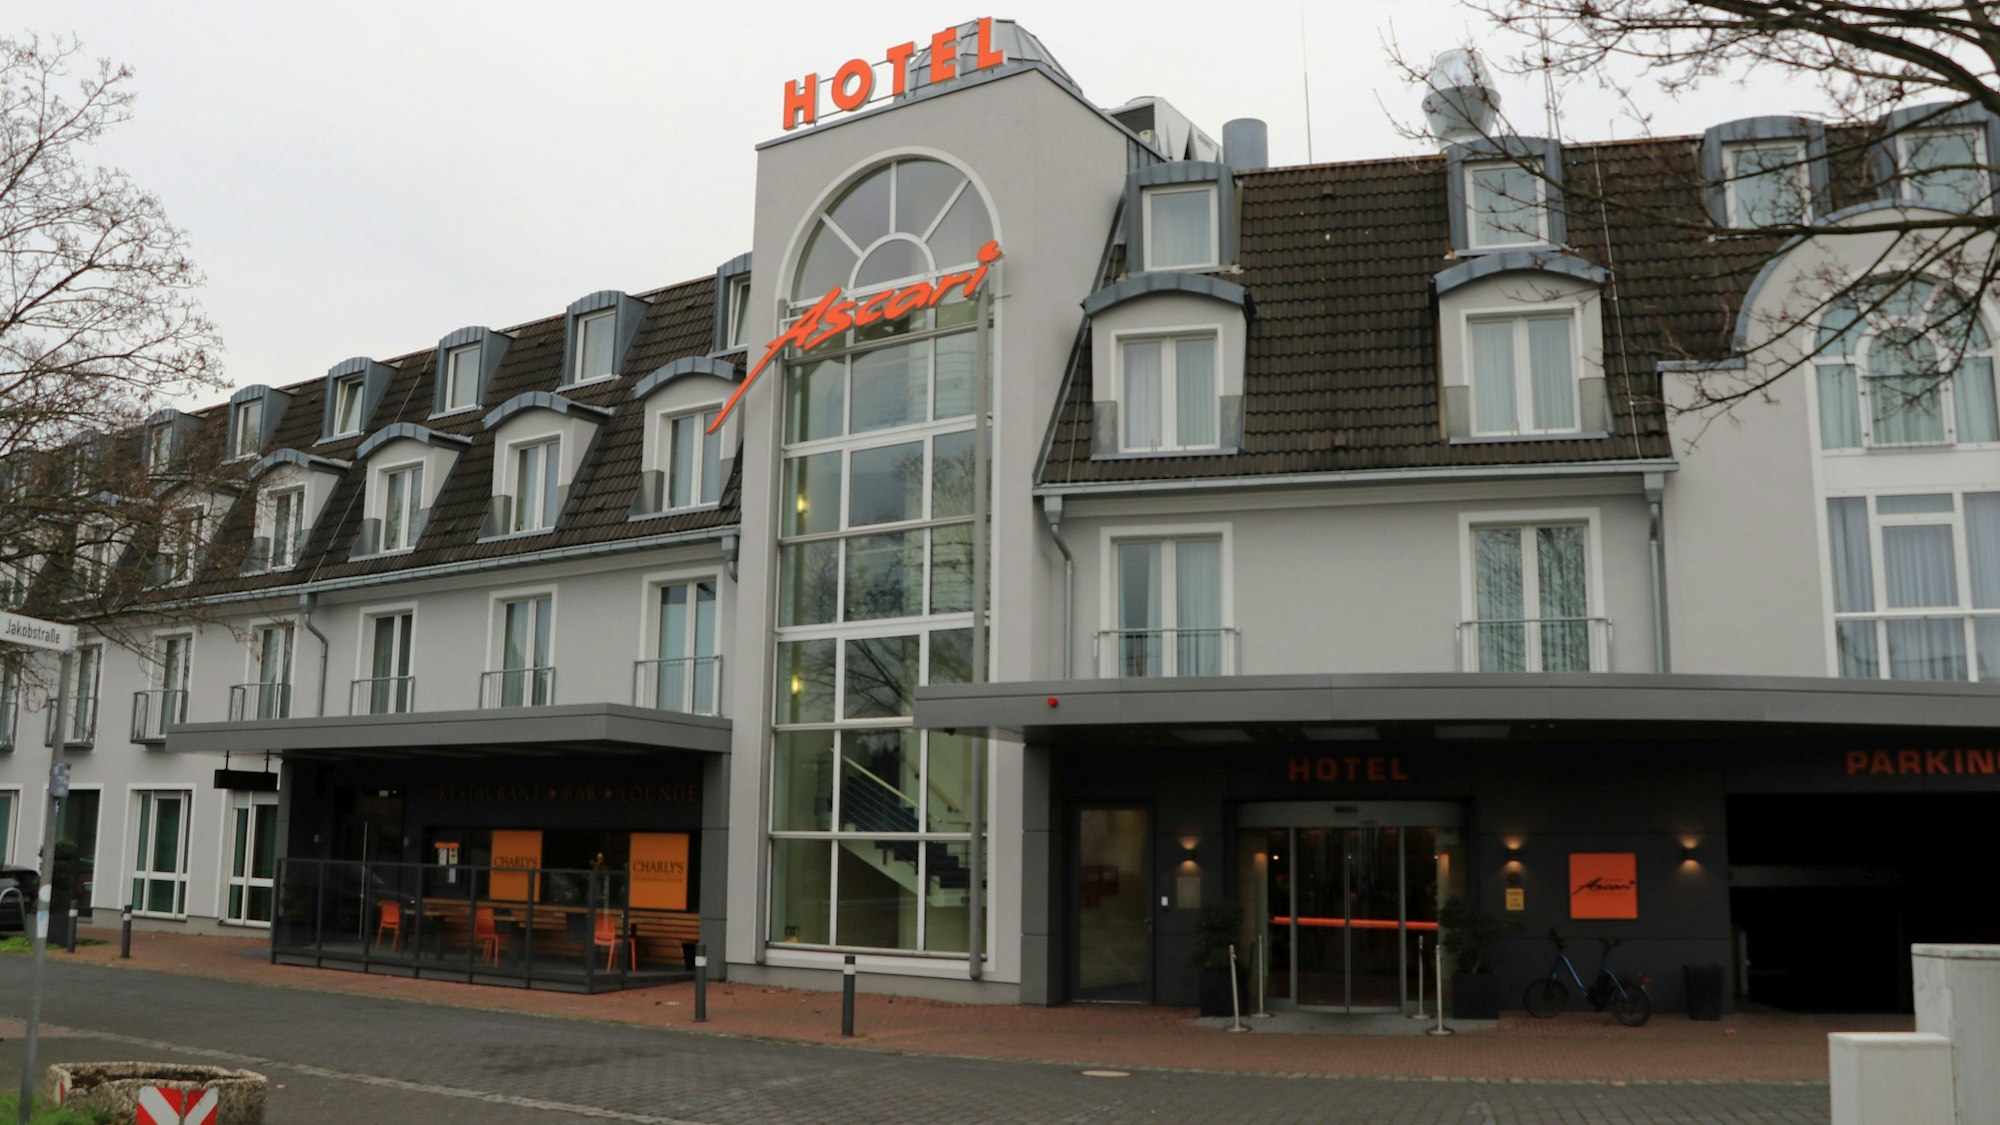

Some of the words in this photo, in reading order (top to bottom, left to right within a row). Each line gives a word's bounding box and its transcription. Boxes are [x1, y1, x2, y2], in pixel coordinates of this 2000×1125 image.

[783, 16, 1006, 131] HOTEL
[706, 240, 1005, 434] Ascari
[5, 618, 61, 644] Jakobstraße
[1288, 757, 1409, 781] HOTEL
[439, 784, 541, 800] RESTAURANT
[563, 784, 598, 800] BAR
[622, 784, 699, 801] LOUNGE
